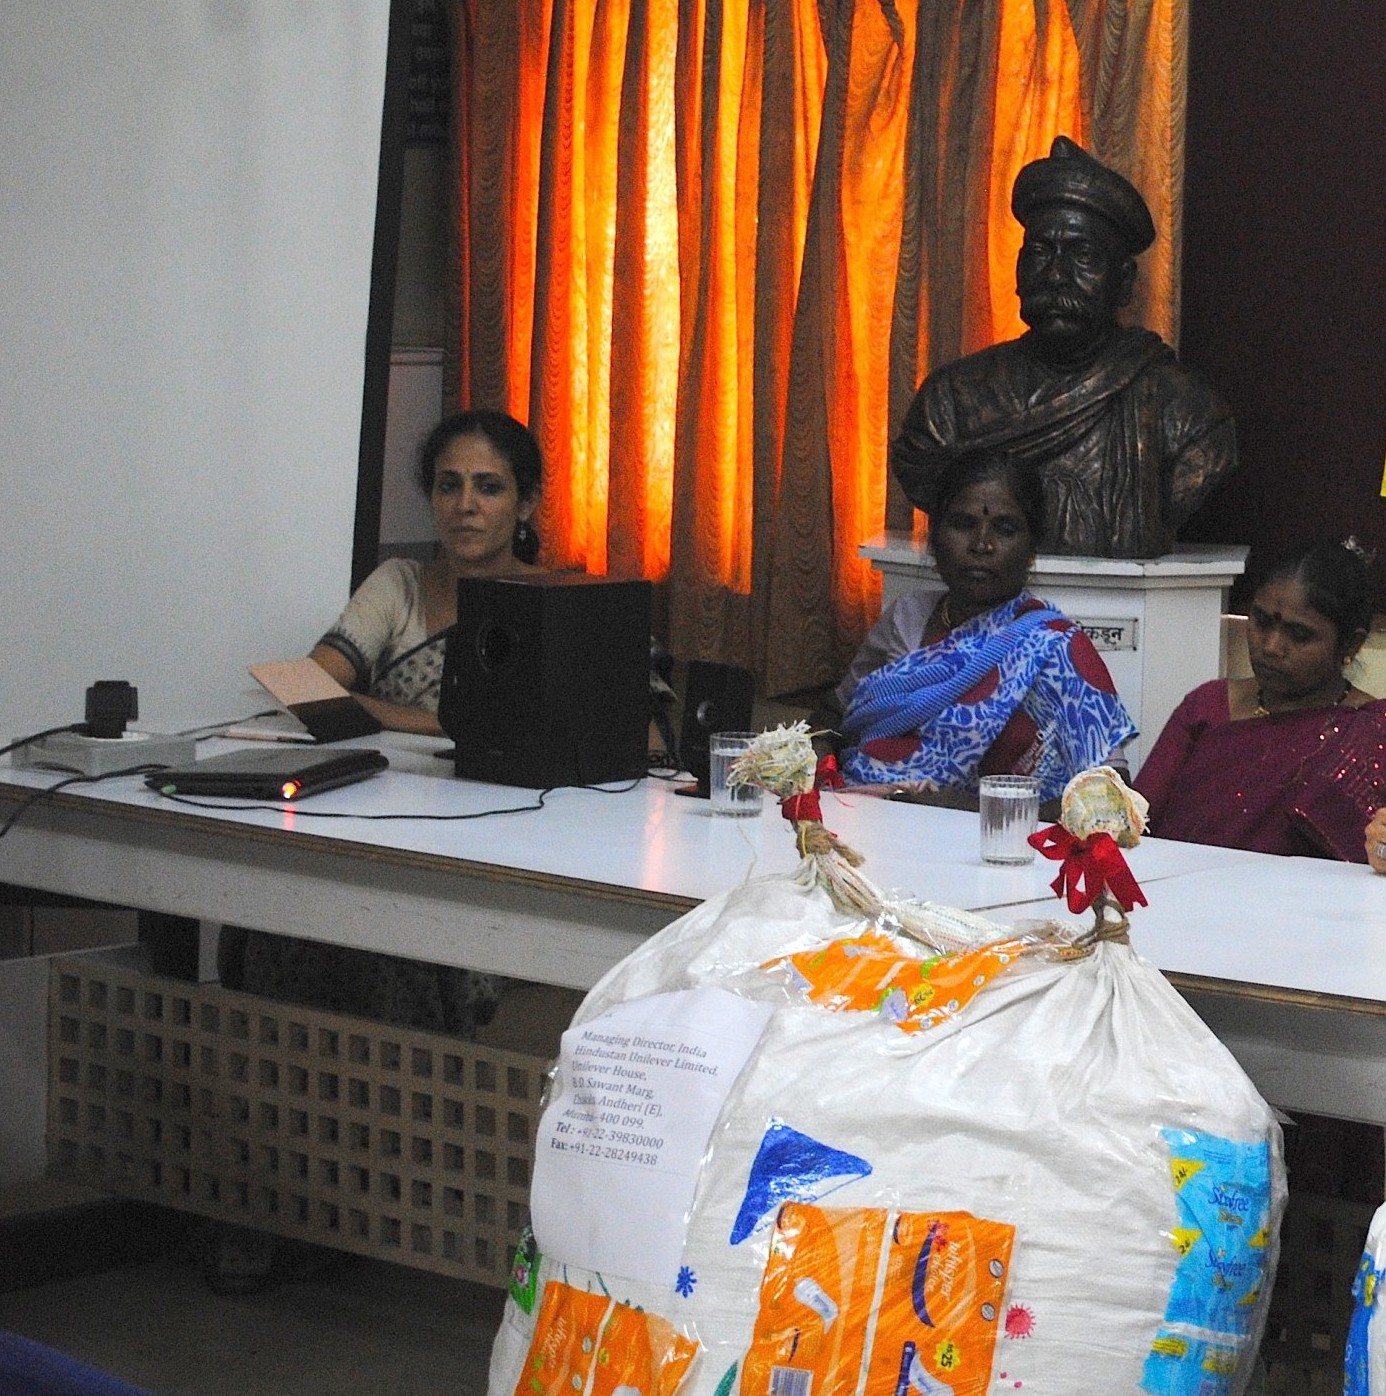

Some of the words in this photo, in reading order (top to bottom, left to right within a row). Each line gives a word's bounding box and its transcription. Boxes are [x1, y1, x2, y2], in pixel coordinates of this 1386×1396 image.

[574, 1045, 627, 1061] Hindustan
[628, 1051, 673, 1067] Unilever
[581, 1031, 631, 1049] Managing
[678, 1043, 707, 1059] India
[598, 1096, 643, 1113] Andheri
